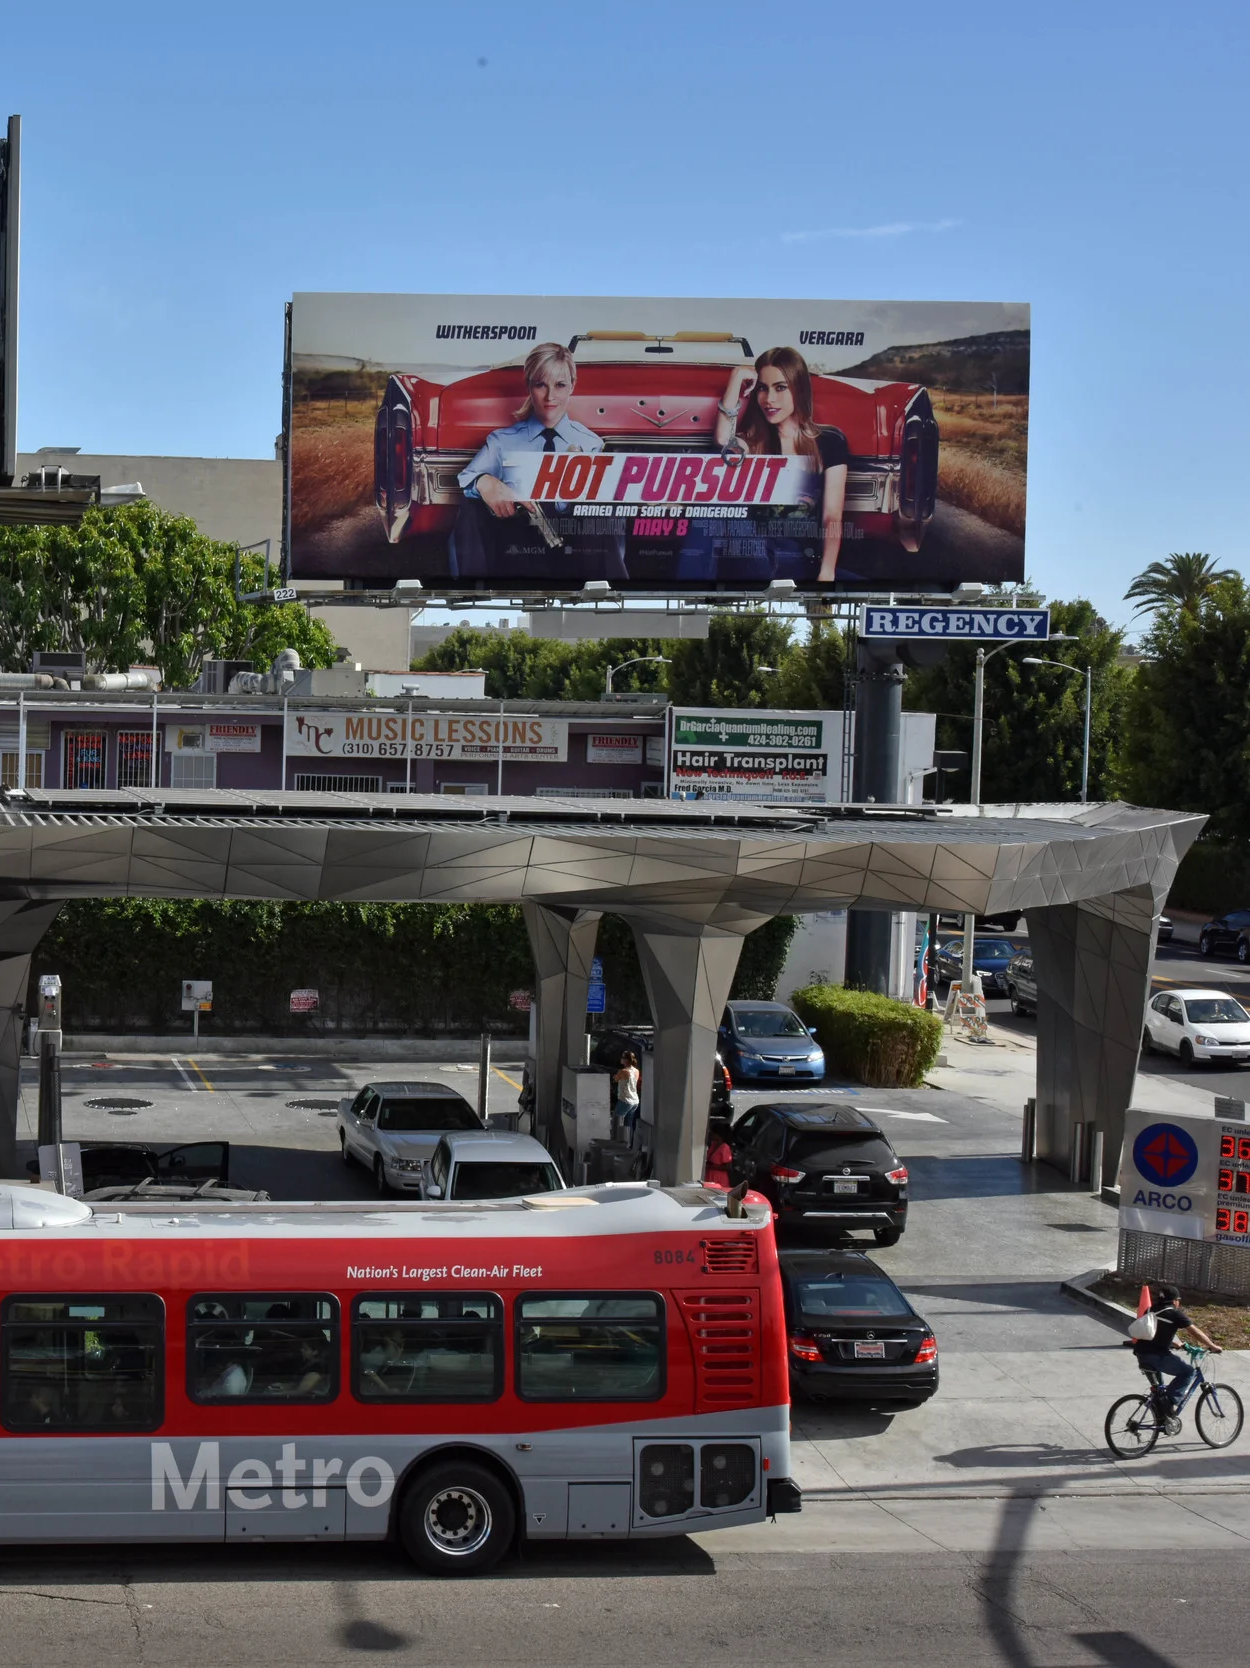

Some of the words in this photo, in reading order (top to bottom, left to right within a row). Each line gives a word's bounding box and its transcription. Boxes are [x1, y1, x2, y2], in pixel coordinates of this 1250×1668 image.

[435, 325, 538, 340] WITHERSPOON
[799, 330, 865, 346] VERGARA
[529, 454, 615, 500] HOT
[613, 455, 789, 503] PURSUIT
[573, 504, 613, 517] ARMED
[615, 505, 638, 517] AND
[640, 505, 667, 517] SORT
[669, 506, 683, 518] OF
[684, 506, 749, 518] DANGEROUS
[632, 518, 674, 536] MAY
[676, 519, 689, 536] 8
[276, 589, 295, 599] 222
[869, 611, 1044, 635] REGENCY
[209, 725, 257, 734] FRIENDLY
[345, 717, 425, 742] MUSIC
[433, 718, 543, 745] LESSONS
[679, 719, 817, 737] DrGarciaQuantumHealing.com
[592, 736, 639, 745] FRIENDLY
[747, 733, 816, 747] 424-302-0261
[342, 742, 374, 755] (310)
[676, 751, 719, 767] Hair
[723, 753, 825, 772] Transplant
[674, 784, 691, 792] Fred
[692, 784, 717, 793] Garcia
[1132, 1189, 1193, 1212] ARCO
[653, 1250, 696, 1264] 8084
[102, 1240, 250, 1291] Rapid
[346, 1265, 399, 1279] Nation's
[402, 1265, 449, 1281] Largest
[451, 1265, 510, 1279] Clean-Air
[512, 1264, 544, 1278] Fleet
[150, 1441, 396, 1511] Metro
